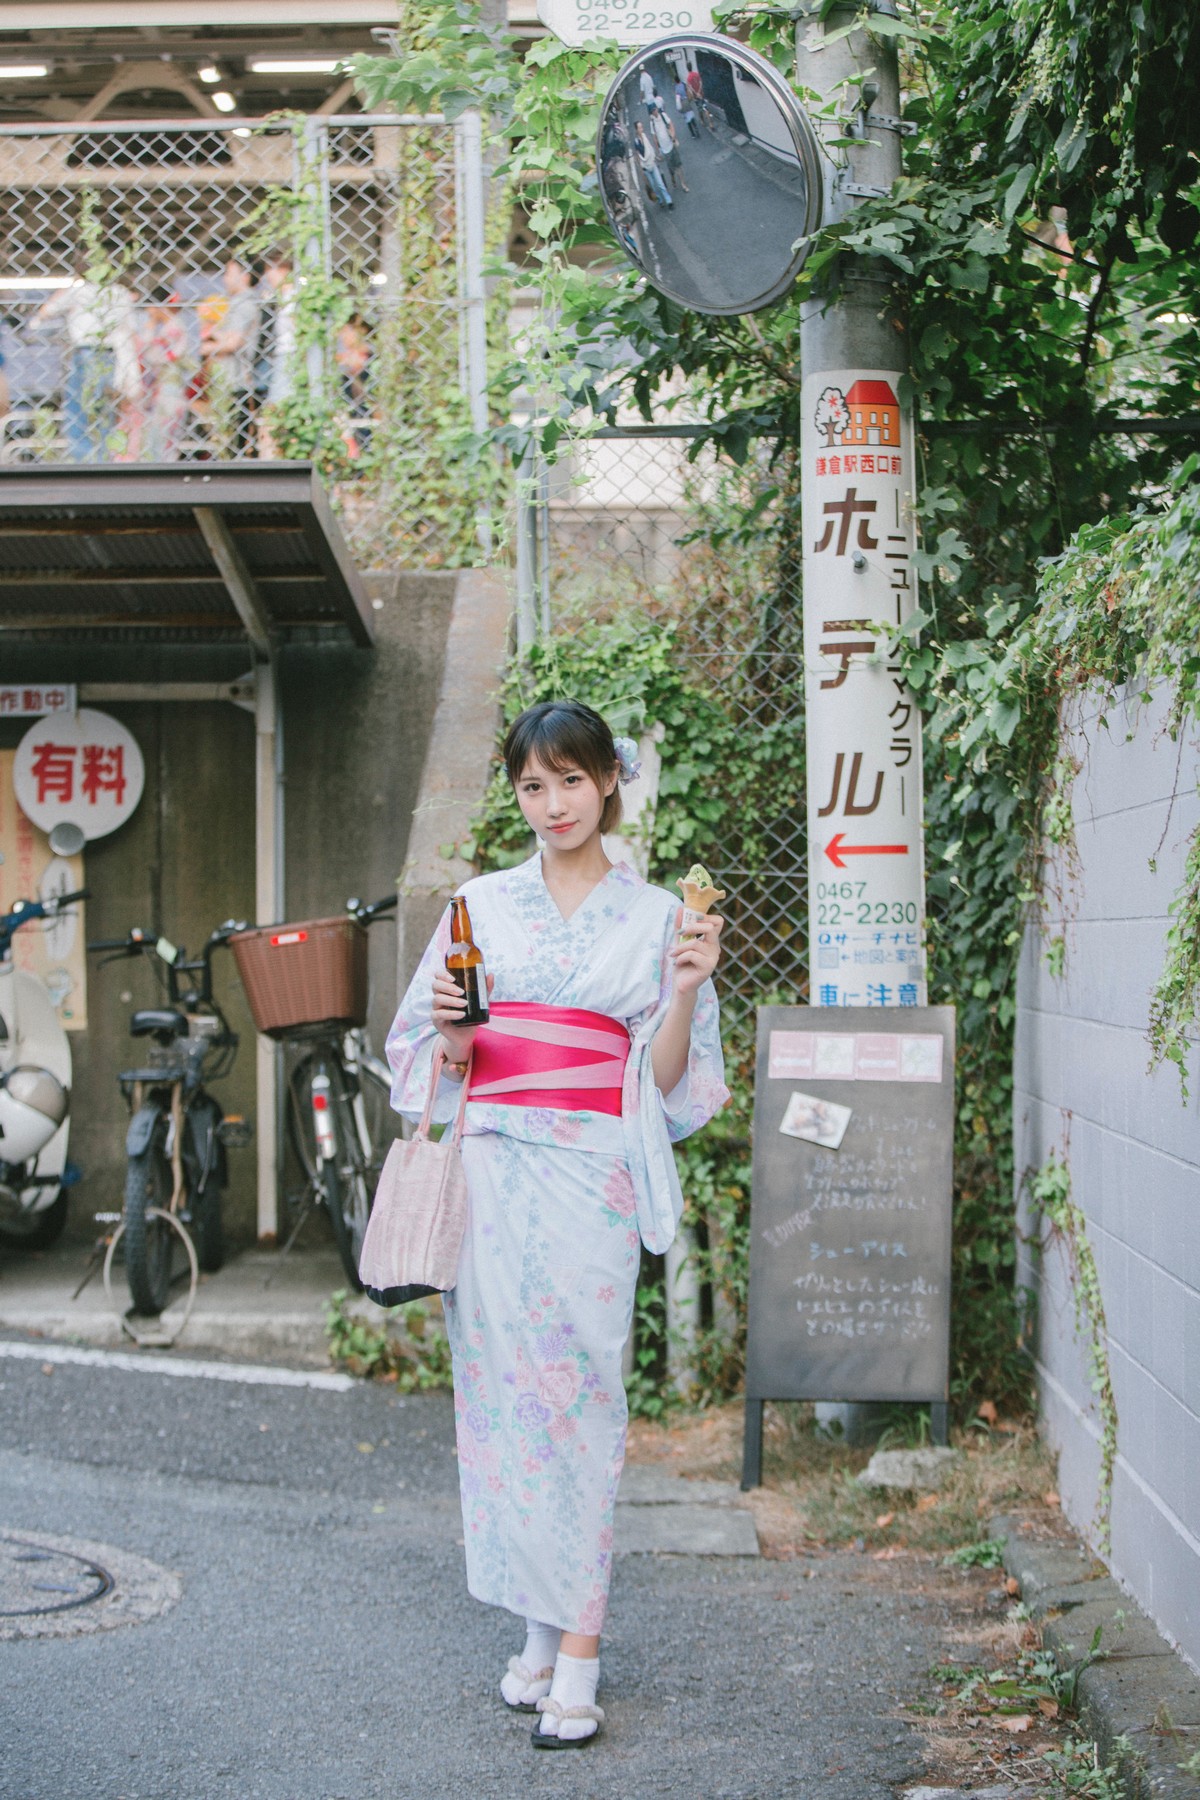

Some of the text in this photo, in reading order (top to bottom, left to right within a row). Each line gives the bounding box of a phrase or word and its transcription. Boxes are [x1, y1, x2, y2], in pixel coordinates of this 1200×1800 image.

[577, 11, 692, 31] 22-2230
[813, 487, 885, 818] ホテル
[0, 689, 65, 712] 作動中
[31, 742, 126, 805] 有料
[816, 882, 867, 900] 0467
[817, 902, 917, 925] 22-2230
[819, 983, 918, 1008] 車に注意
